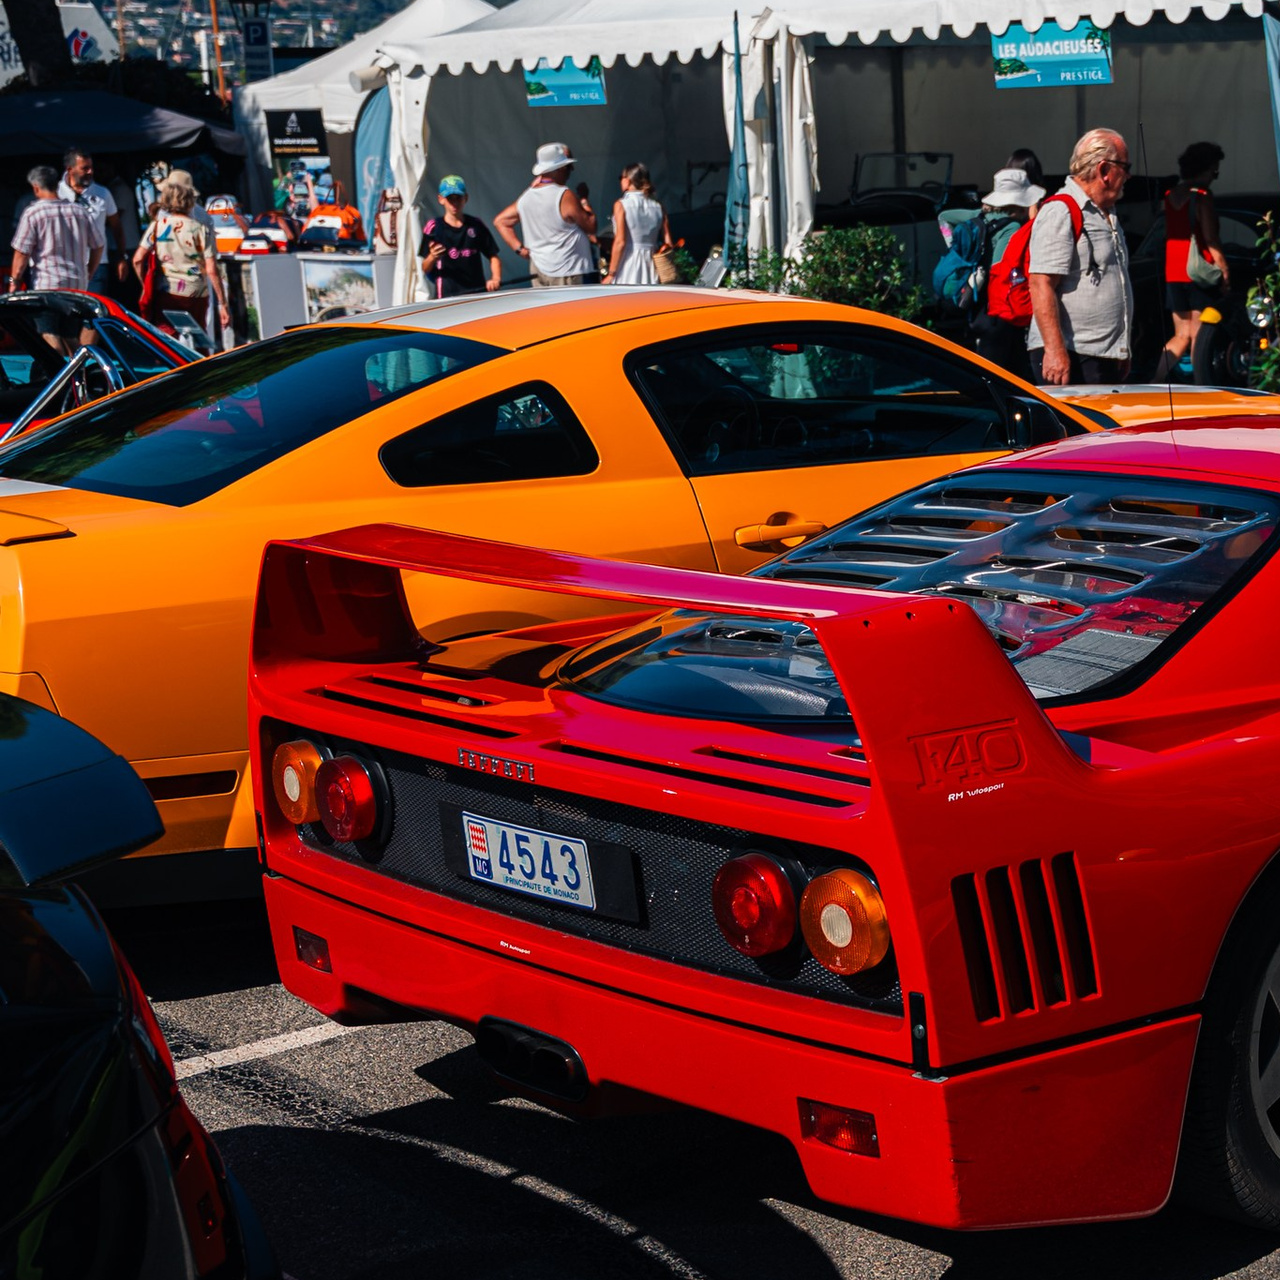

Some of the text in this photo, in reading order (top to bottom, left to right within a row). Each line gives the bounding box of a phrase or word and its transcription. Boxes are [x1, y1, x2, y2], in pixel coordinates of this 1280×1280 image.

[249, 25, 262, 44] P
[998, 38, 1102, 58] LES AUDACIEUSES
[1060, 69, 1106, 81] PRESTIGE
[947, 791, 964, 802] RM
[475, 829, 581, 891] MC 4543
[505, 874, 580, 901] PRINCIPAUTE DE MONACO
